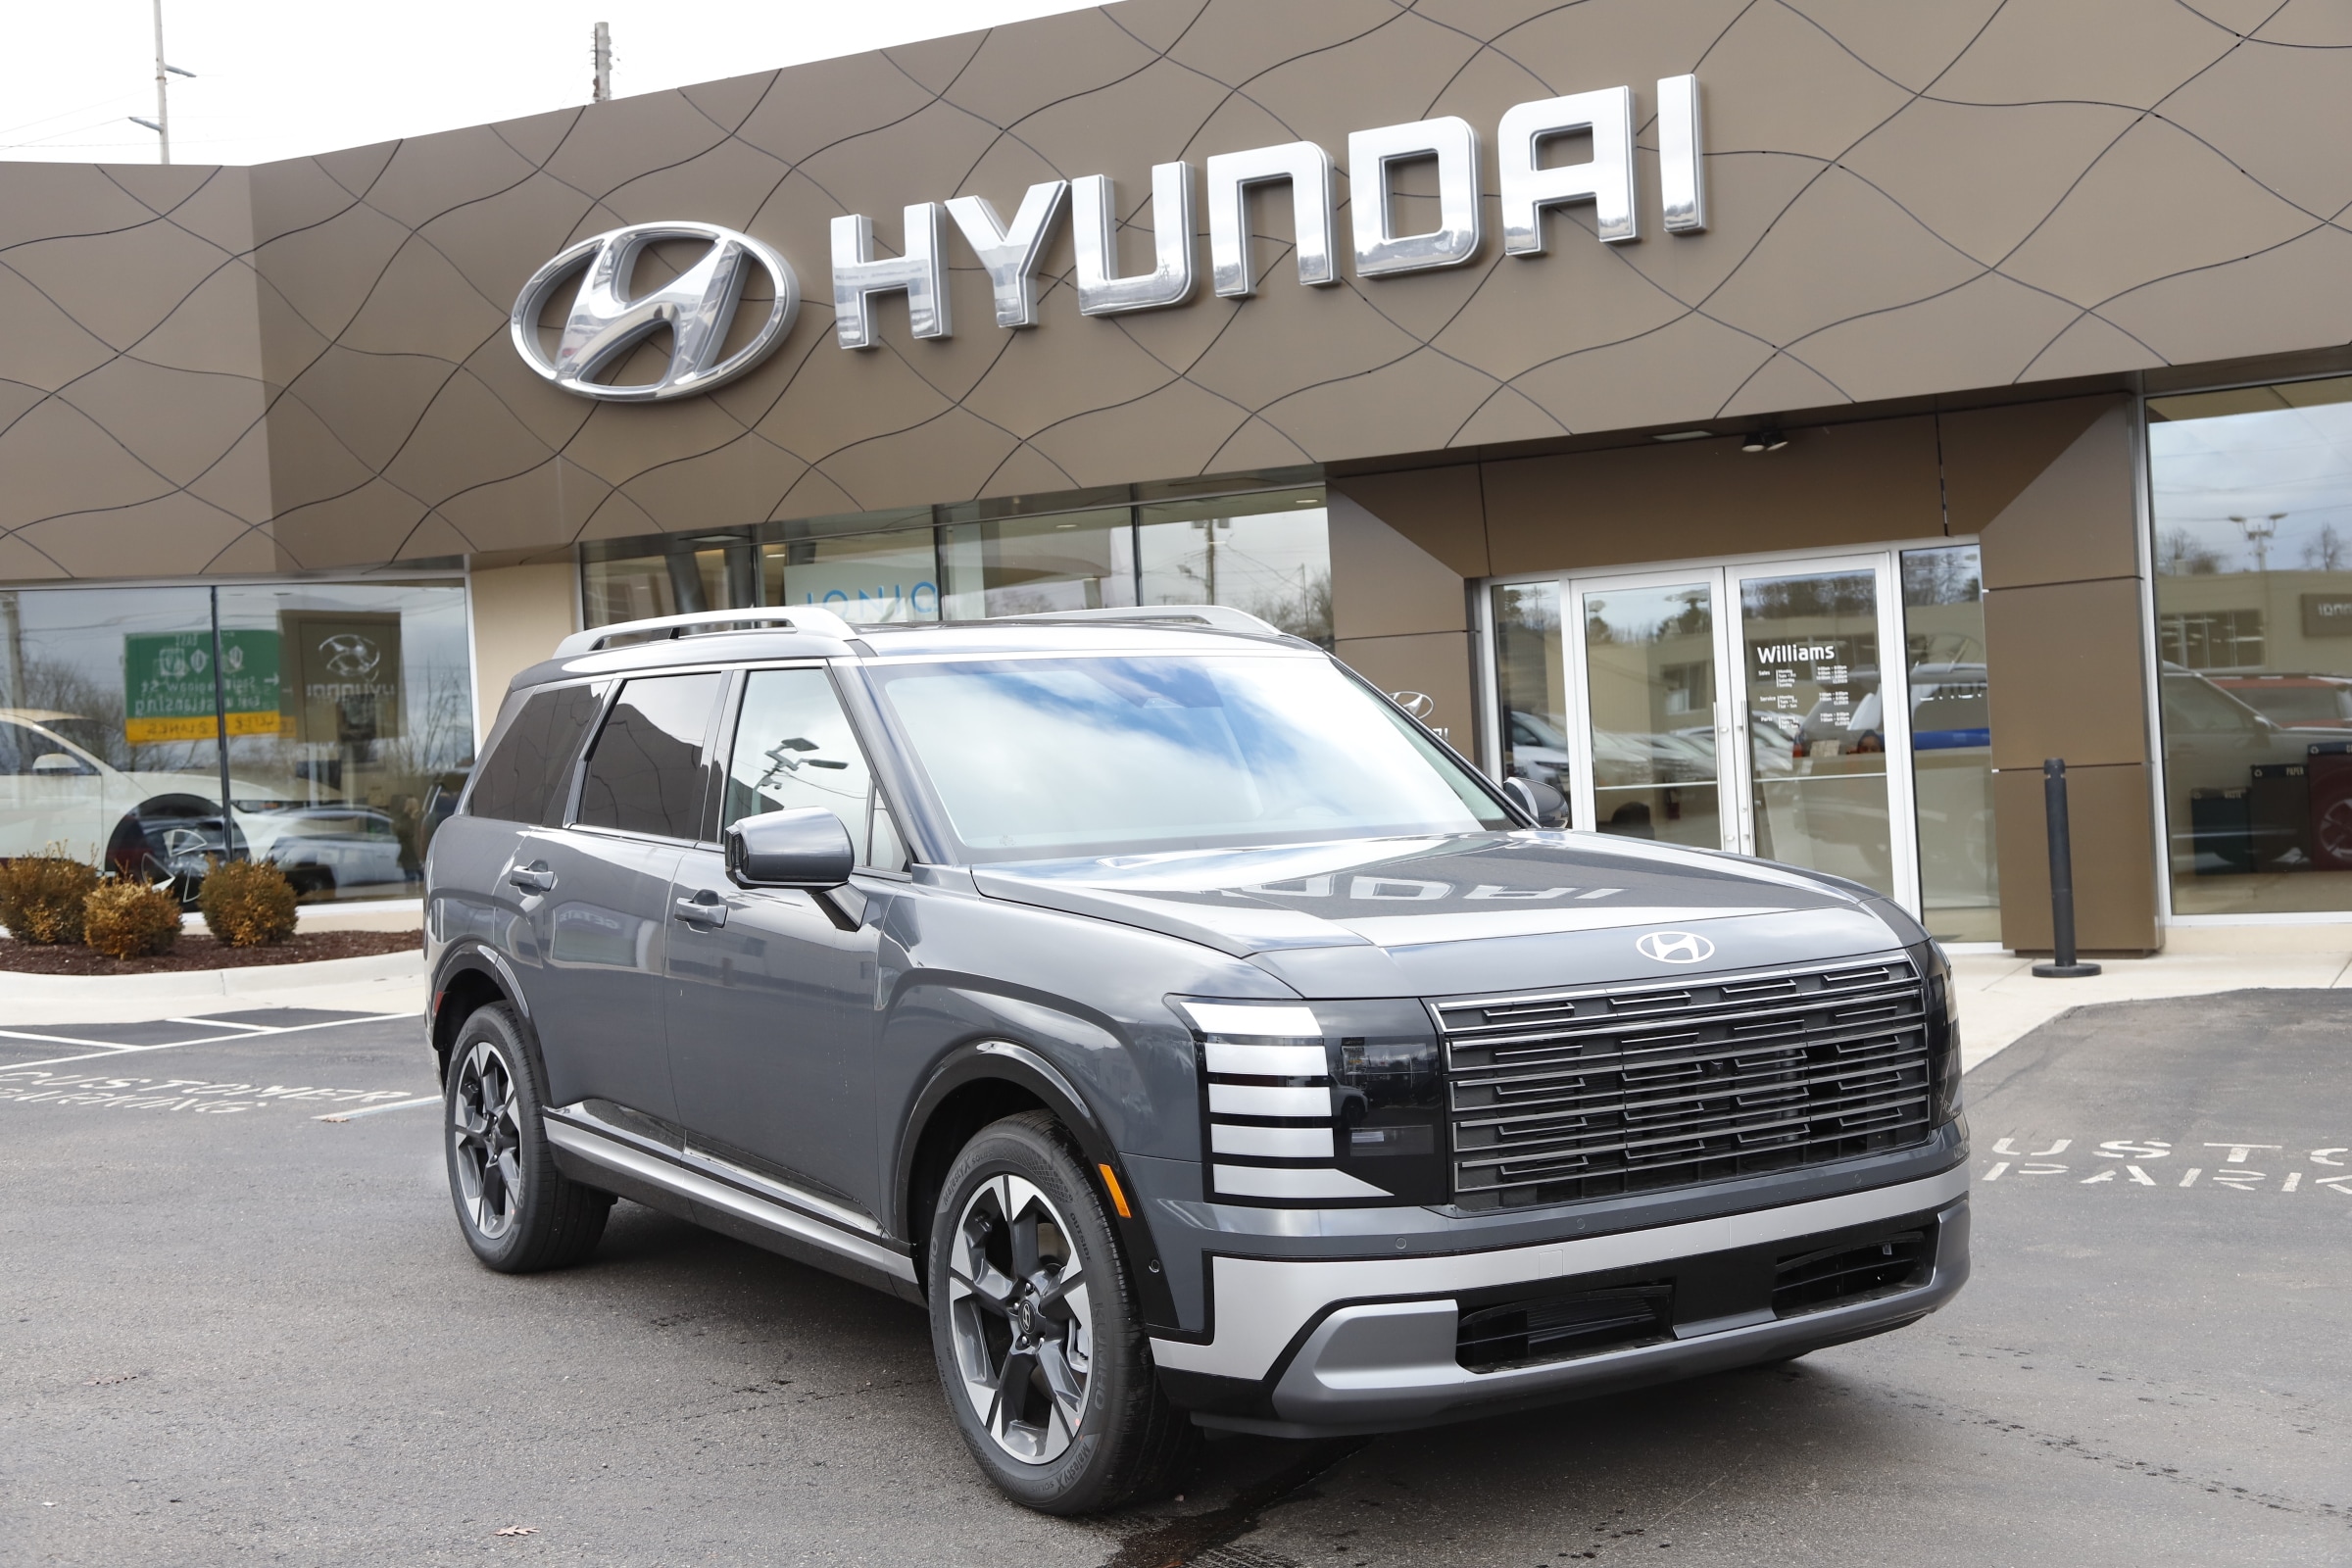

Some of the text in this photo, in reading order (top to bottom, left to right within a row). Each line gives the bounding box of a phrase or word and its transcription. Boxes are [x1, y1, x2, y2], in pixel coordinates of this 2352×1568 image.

[830, 74, 1706, 351] HYUNDAI
[1757, 644, 1835, 663] Williams
[0, 1071, 412, 1103] CUSTOMER
[1094, 1300, 1107, 1410] KUMHO
